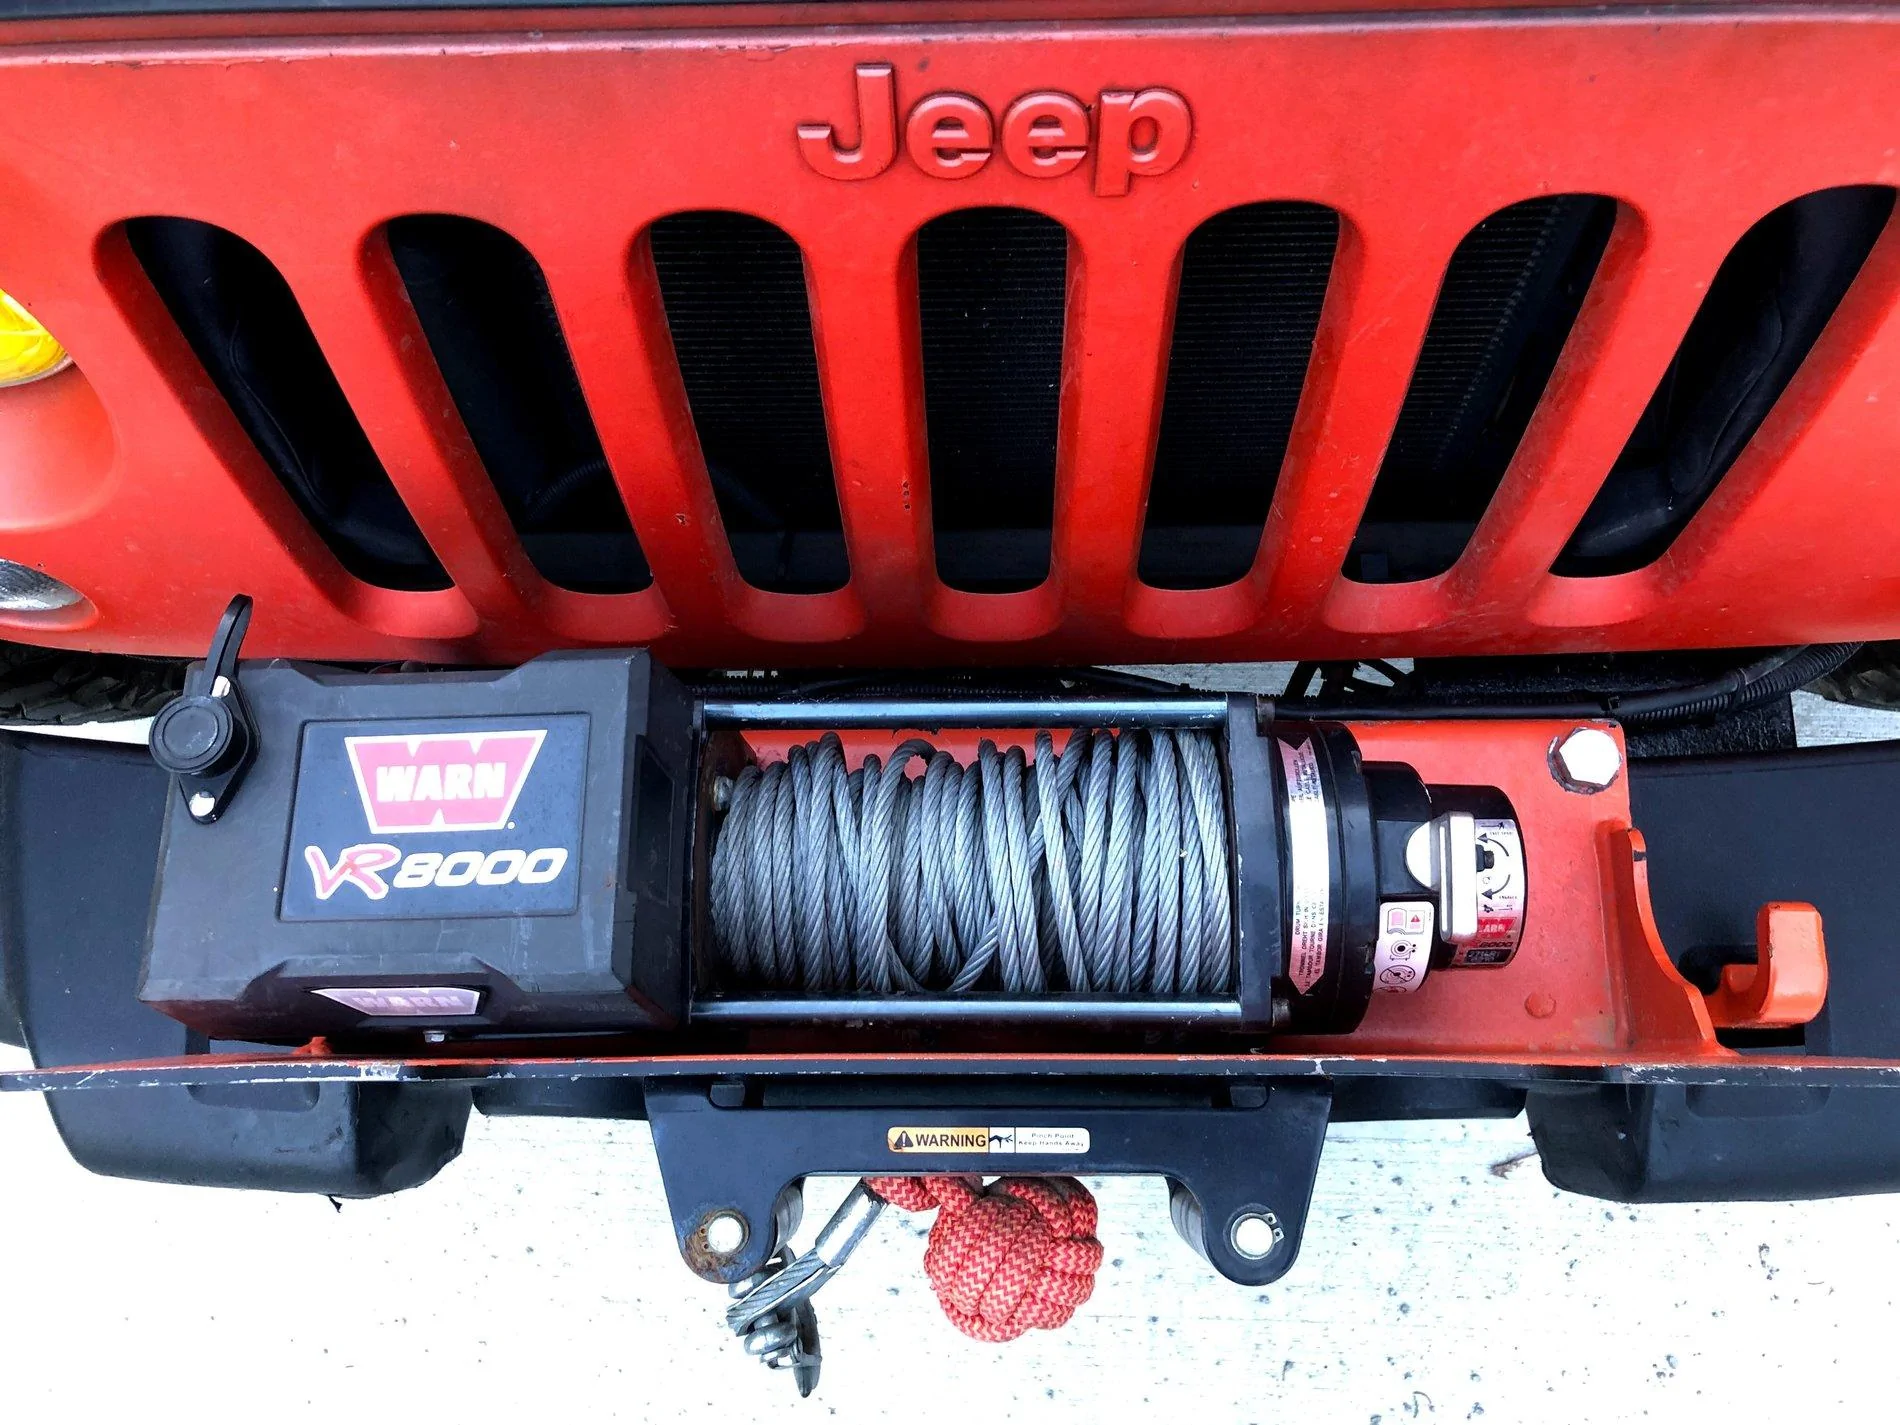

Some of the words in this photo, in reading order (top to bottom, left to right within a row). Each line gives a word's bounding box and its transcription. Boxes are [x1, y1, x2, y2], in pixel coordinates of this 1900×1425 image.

[797, 62, 1194, 197] Jeep
[375, 762, 506, 803] WARN
[304, 843, 568, 900] VR8000
[915, 1134, 986, 1147] WARNING
